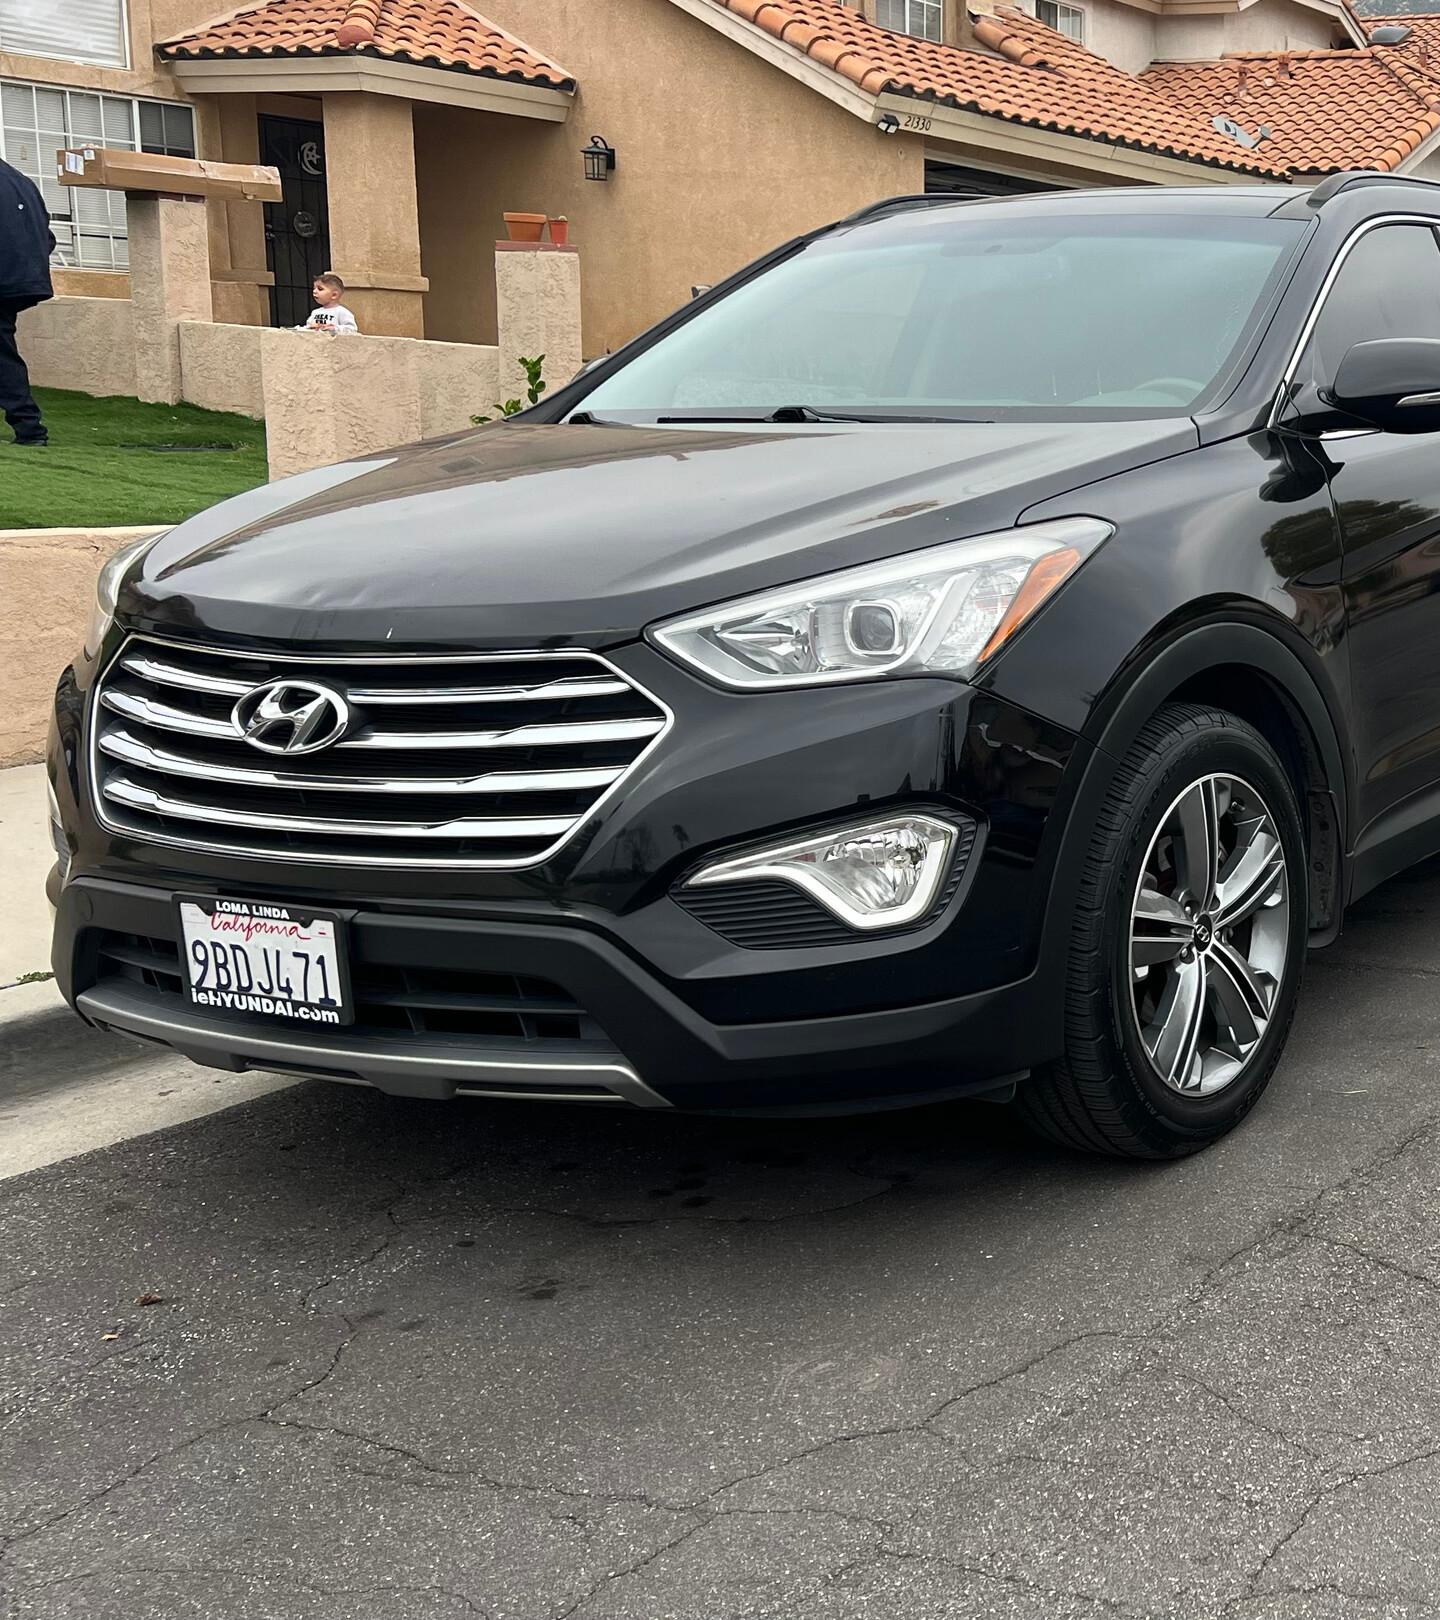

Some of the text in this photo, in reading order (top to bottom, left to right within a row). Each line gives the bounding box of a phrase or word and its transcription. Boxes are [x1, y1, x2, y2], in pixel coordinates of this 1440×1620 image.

[904, 115, 931, 131] 21330
[215, 901, 290, 920] LOMA LINDA
[211, 911, 311, 941] California
[191, 939, 337, 1006] 9BDJ471
[191, 987, 340, 1023] ieHYUNDAI.com
